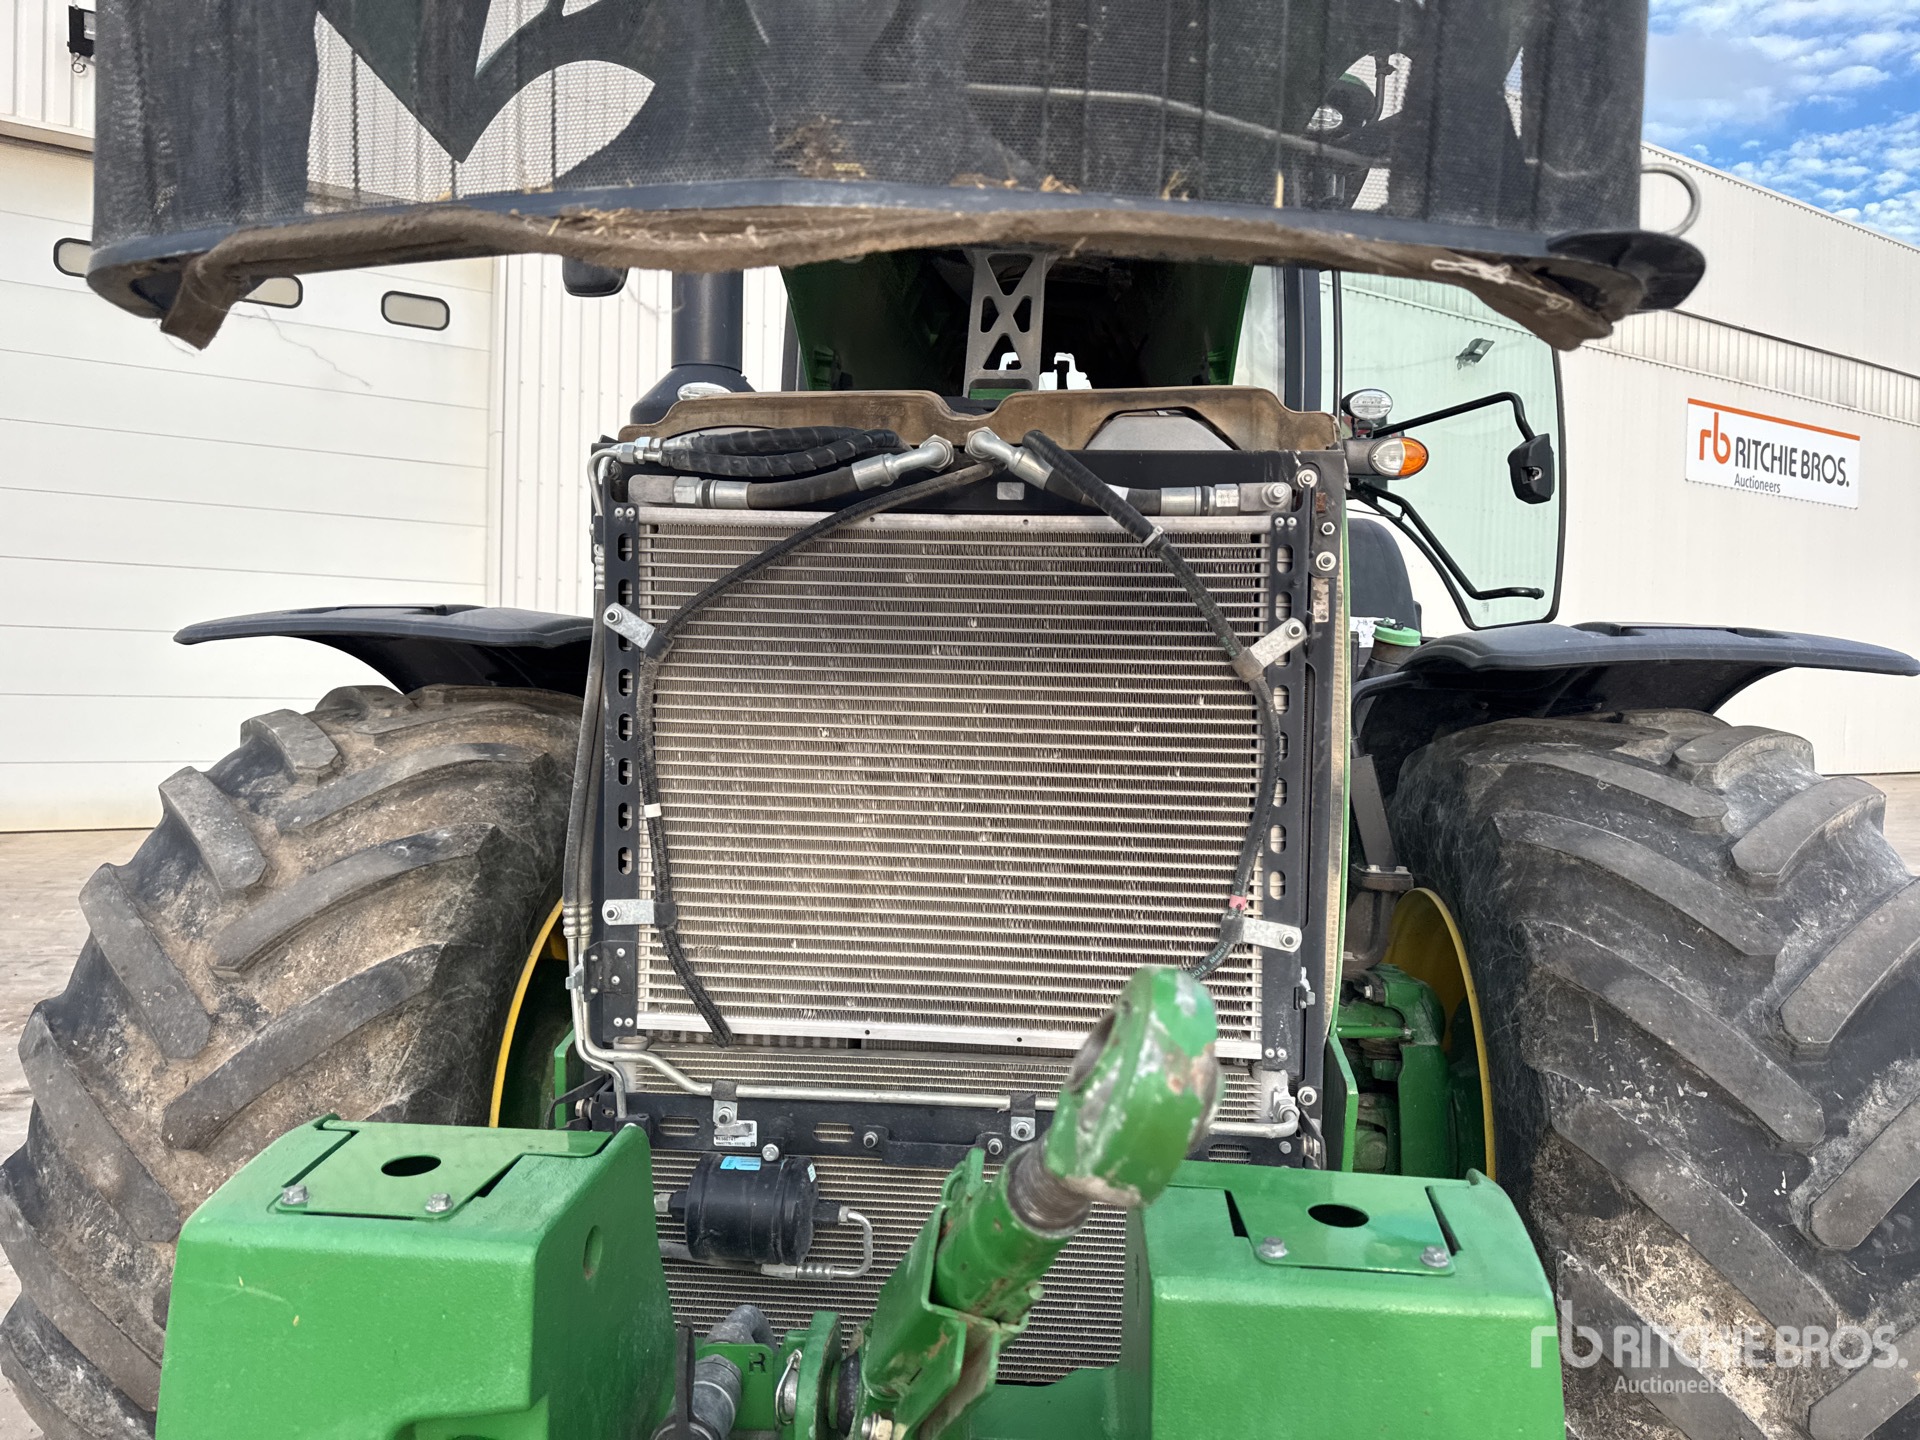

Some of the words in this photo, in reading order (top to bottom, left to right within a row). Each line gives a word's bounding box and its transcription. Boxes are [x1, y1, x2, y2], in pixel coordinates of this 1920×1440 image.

[1735, 436, 1797, 477] RITCHIE
[1801, 449, 1850, 487] BROS.
[1734, 473, 1781, 494] Auctioneers
[1209, 947, 1225, 964] Made
